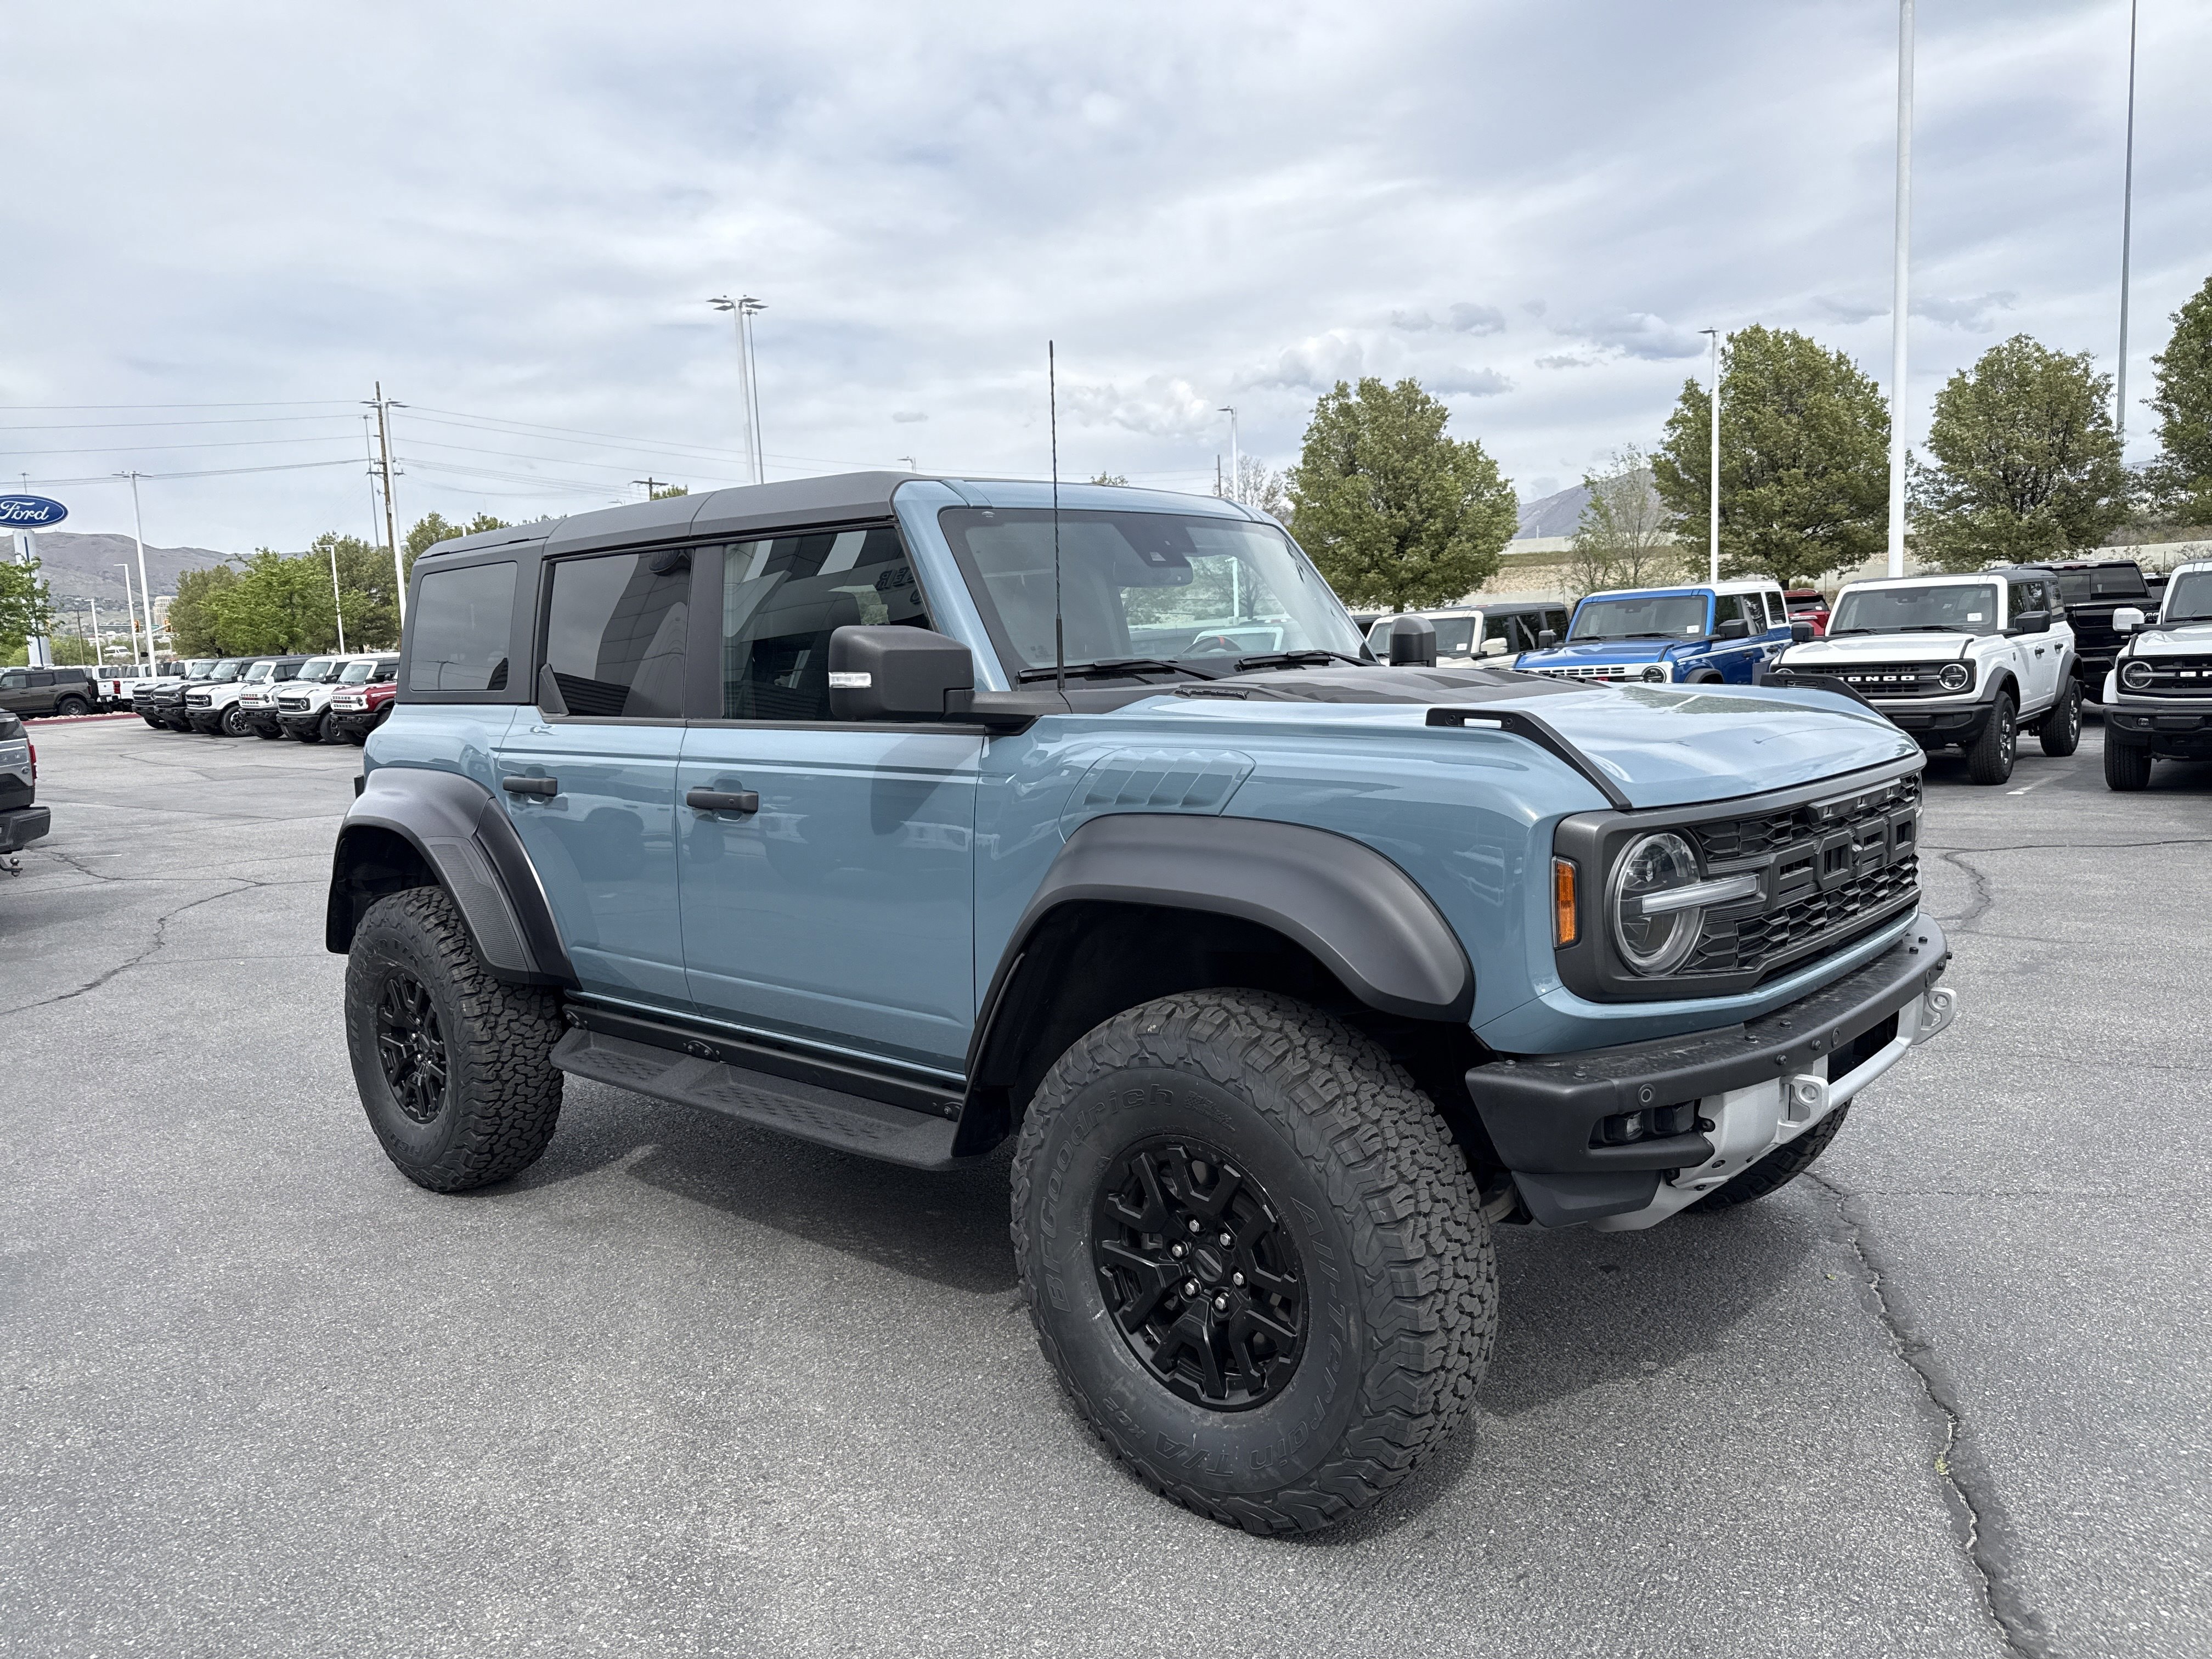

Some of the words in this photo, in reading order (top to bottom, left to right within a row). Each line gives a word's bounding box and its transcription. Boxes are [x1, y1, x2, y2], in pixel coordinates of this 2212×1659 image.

[0, 500, 49, 520] Ford
[1768, 806, 1916, 910] FORD
[1040, 1084, 1174, 1313] BFGoodrich
[1250, 1197, 1347, 1470] All-Terrain
[1154, 1430, 1234, 1477] T/A
